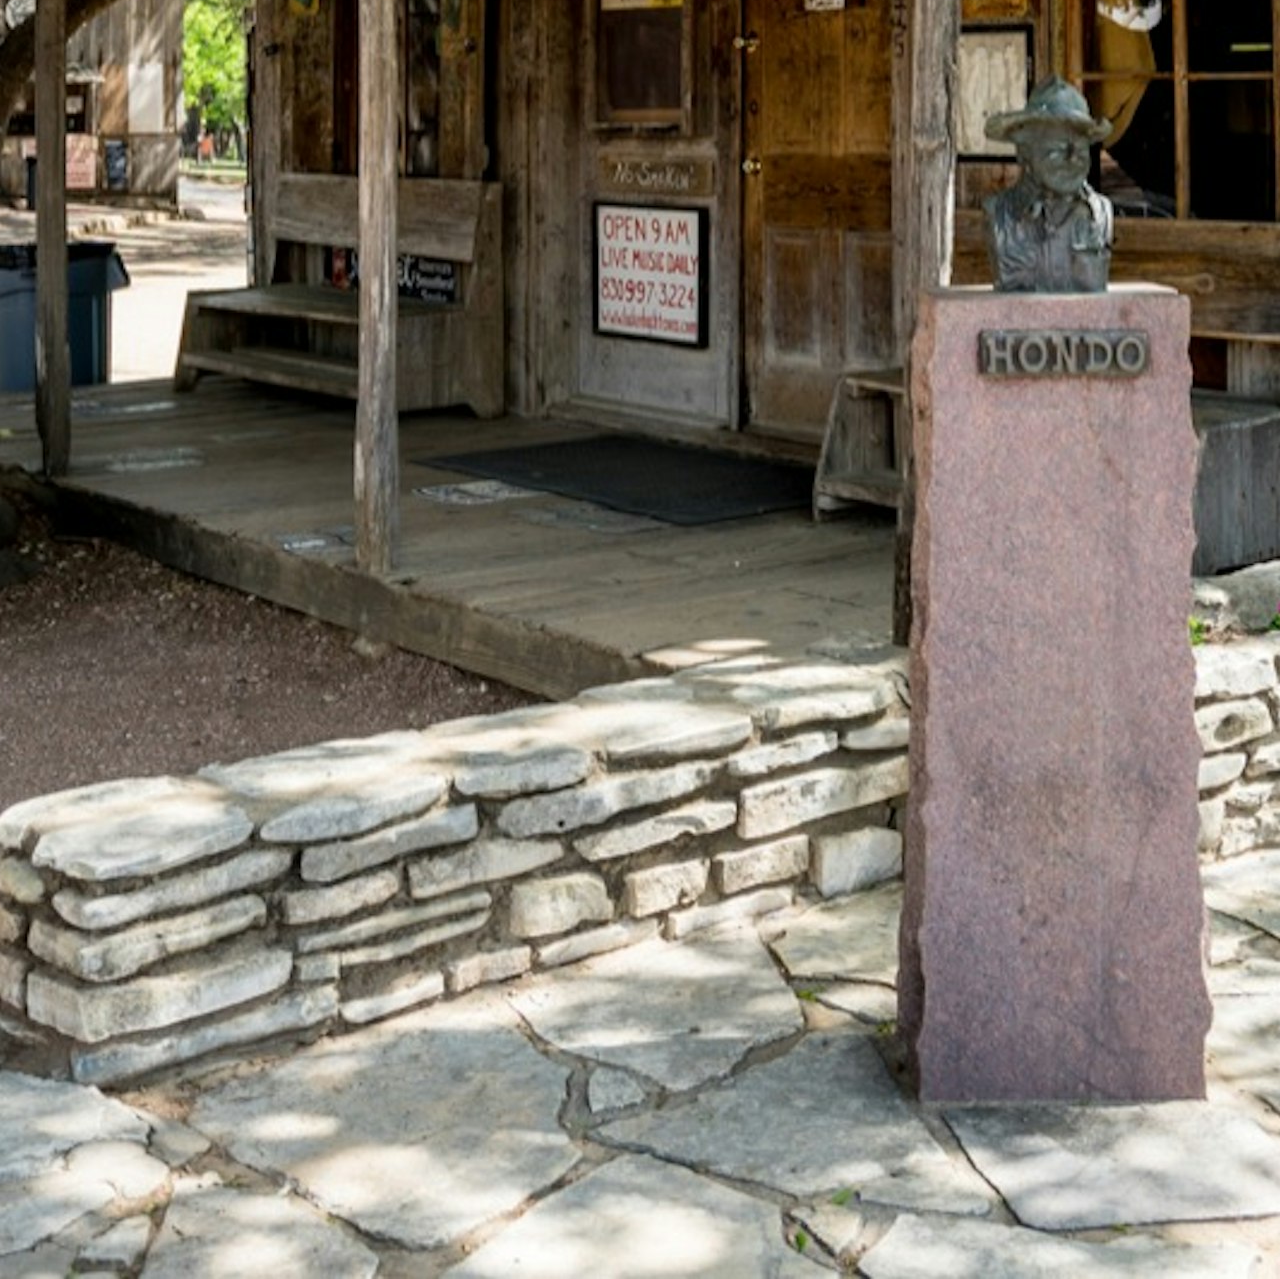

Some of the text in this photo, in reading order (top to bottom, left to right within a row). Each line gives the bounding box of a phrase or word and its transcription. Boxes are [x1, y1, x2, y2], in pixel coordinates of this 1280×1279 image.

[603, 213, 690, 245] OPEN 9 AM
[600, 246, 698, 276] LIVE MUSIC DAILY
[658, 281, 696, 309] 3224
[986, 334, 1146, 373] HONDO
